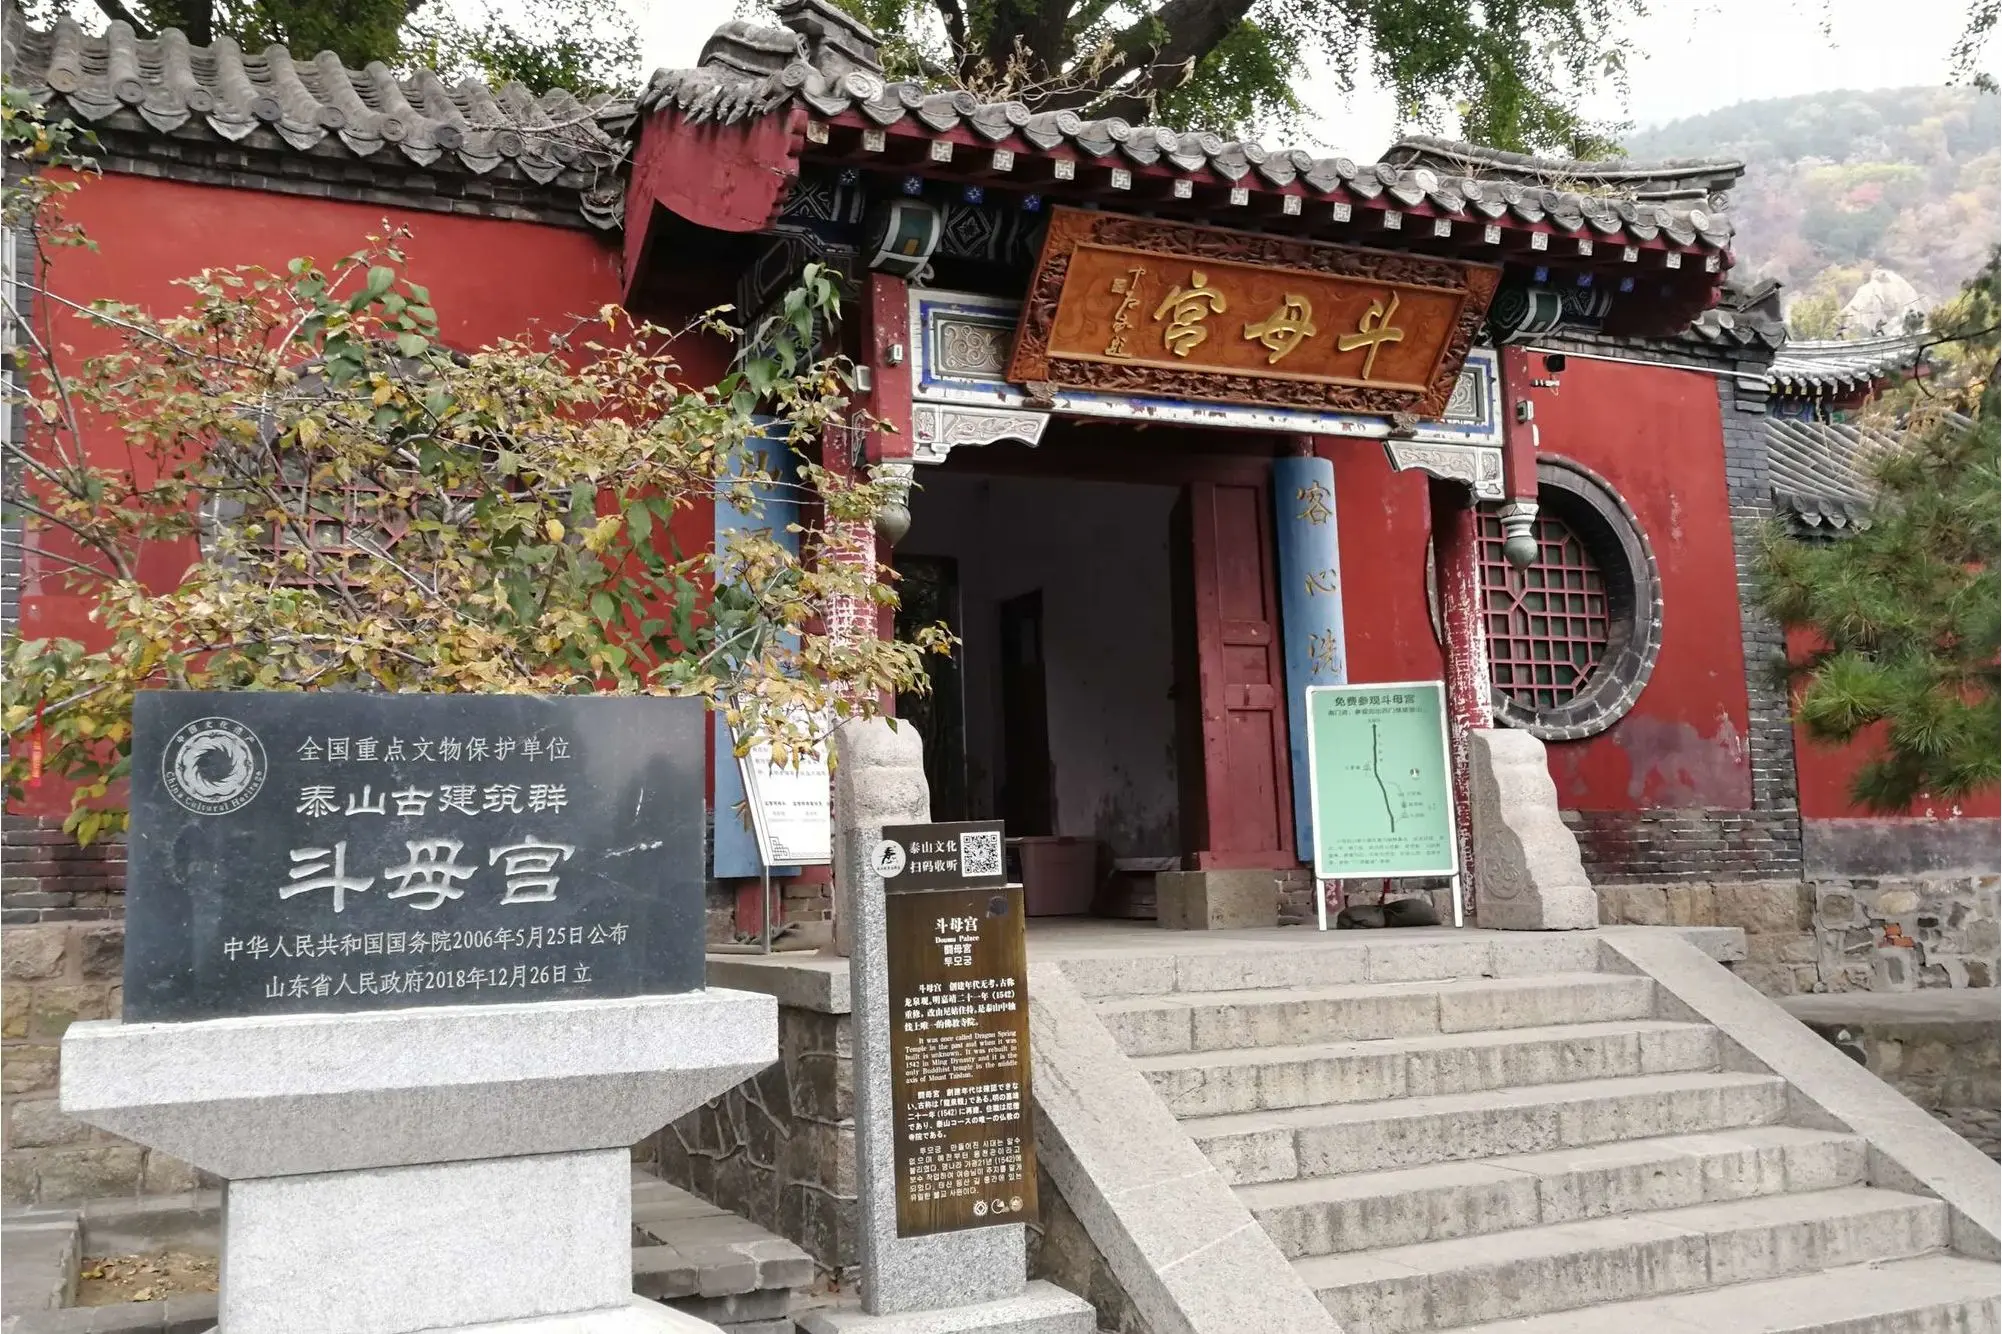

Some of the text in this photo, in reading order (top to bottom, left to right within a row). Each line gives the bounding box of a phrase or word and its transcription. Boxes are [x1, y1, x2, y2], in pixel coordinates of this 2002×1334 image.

[1335, 694, 1416, 706] 免费参观斗母宫
[296, 735, 571, 763] 全国重点文物保护单位
[296, 783, 568, 818] 泰山古建筑群
[910, 840, 958, 854] 泰山文化
[279, 834, 576, 913] 斗母宫
[910, 859, 958, 874] 扫码收听
[935, 916, 978, 934] 斗母宫
[223, 922, 630, 961] 中华人民共和国国务院2006年5月25日公布
